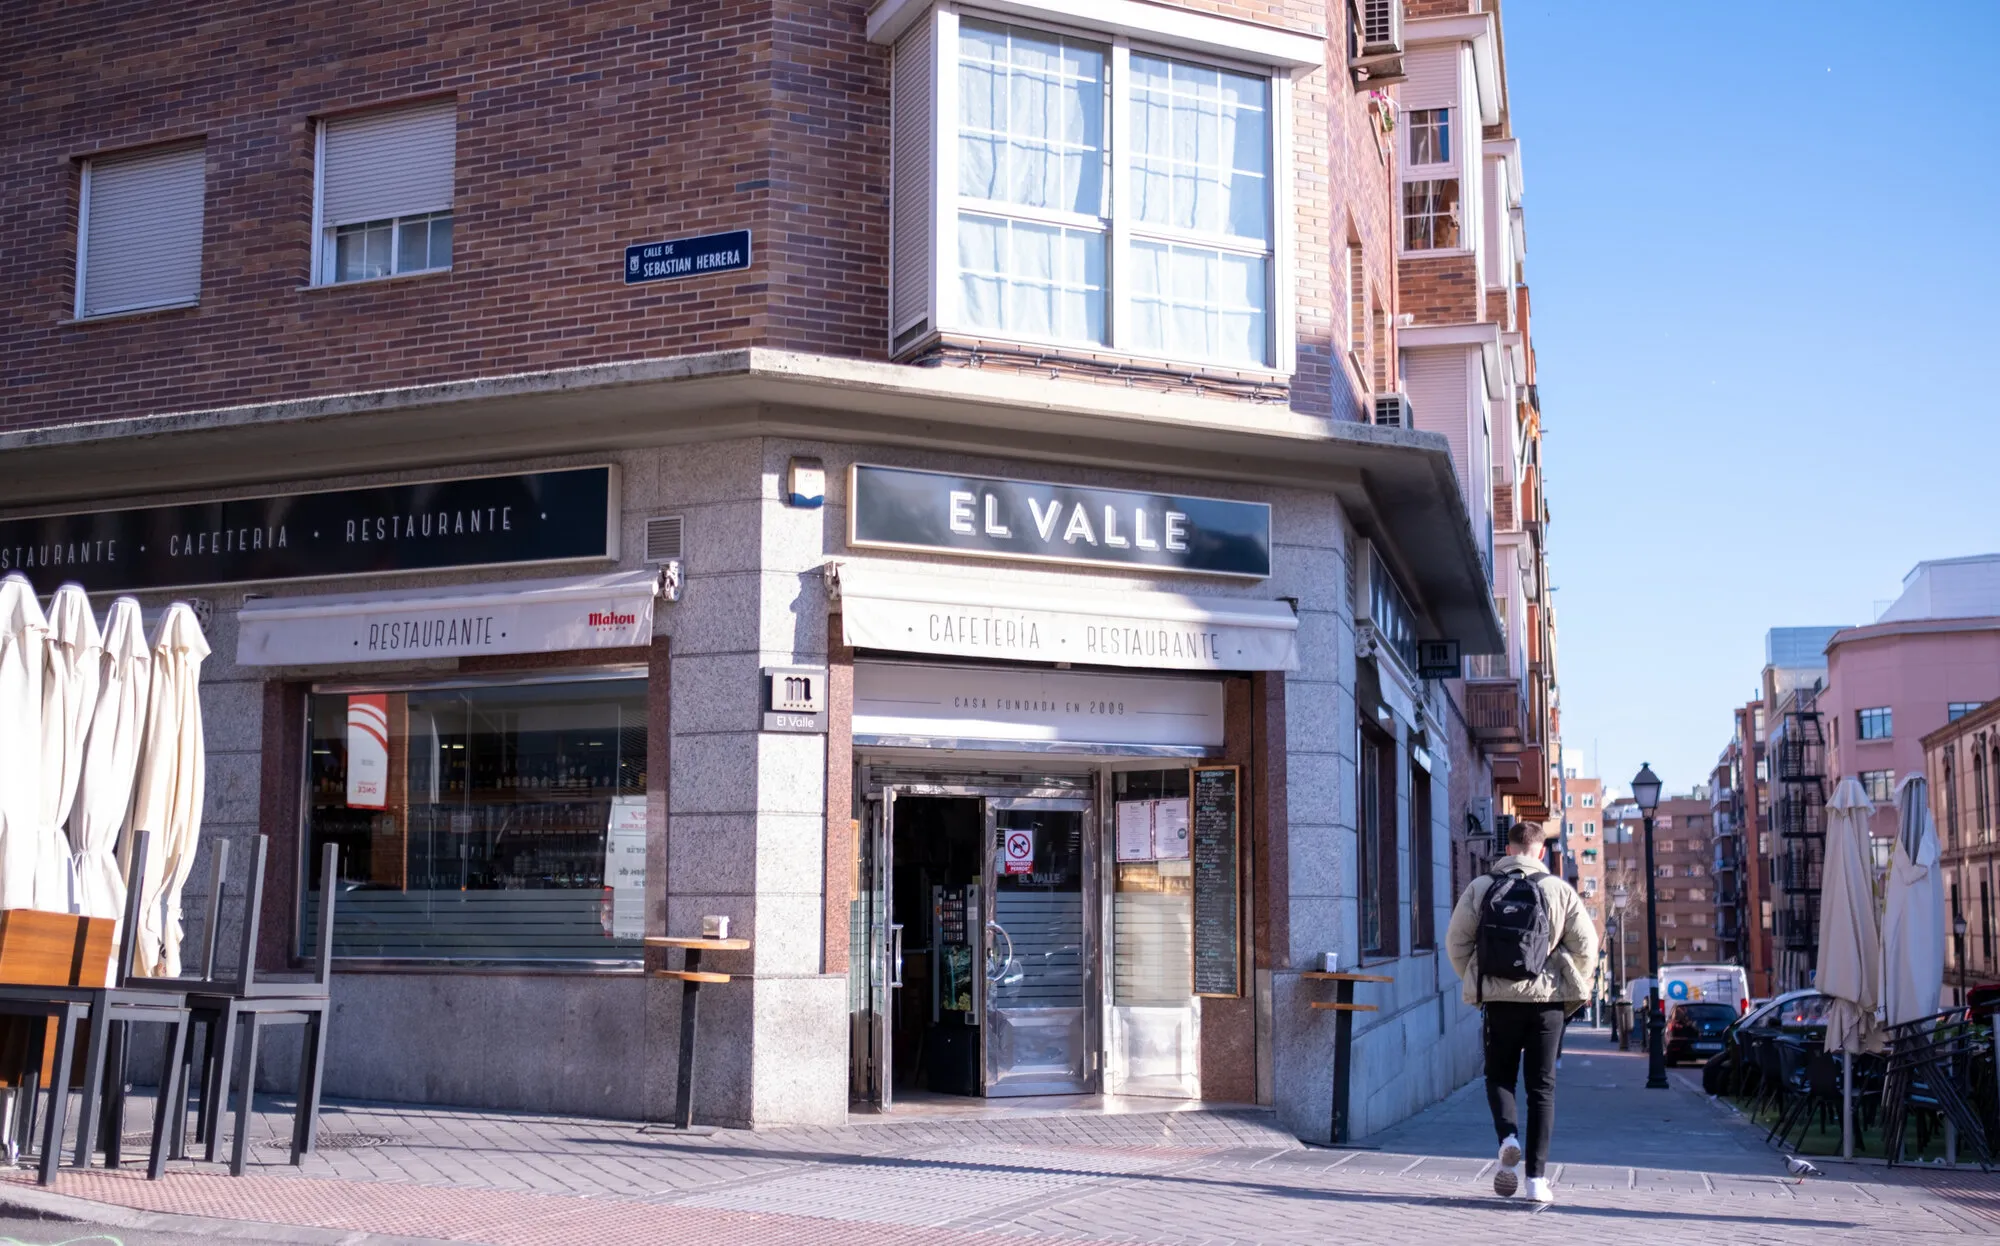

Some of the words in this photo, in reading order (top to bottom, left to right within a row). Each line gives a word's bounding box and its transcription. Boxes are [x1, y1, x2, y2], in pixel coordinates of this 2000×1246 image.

[643, 246, 662, 258] CALLE
[665, 244, 674, 255] DE
[643, 257, 692, 278] SEBASTIAN
[696, 249, 741, 270] HERRERA
[346, 506, 512, 542] RESTAURANTE
[950, 490, 1012, 539] EL
[1027, 498, 1190, 554] VALLE
[588, 611, 635, 626] Mahou
[368, 616, 493, 651] RESTAURANTE
[929, 613, 1040, 649] CAFETERÍA
[1087, 625, 1221, 660] RESTAURANTE
[954, 696, 987, 709] CASA
[997, 698, 1055, 712] FUNDADA
[1066, 702, 1080, 713] EN
[1089, 701, 1124, 715] 2009
[776, 715, 786, 727] El
[788, 715, 815, 728] Valle
